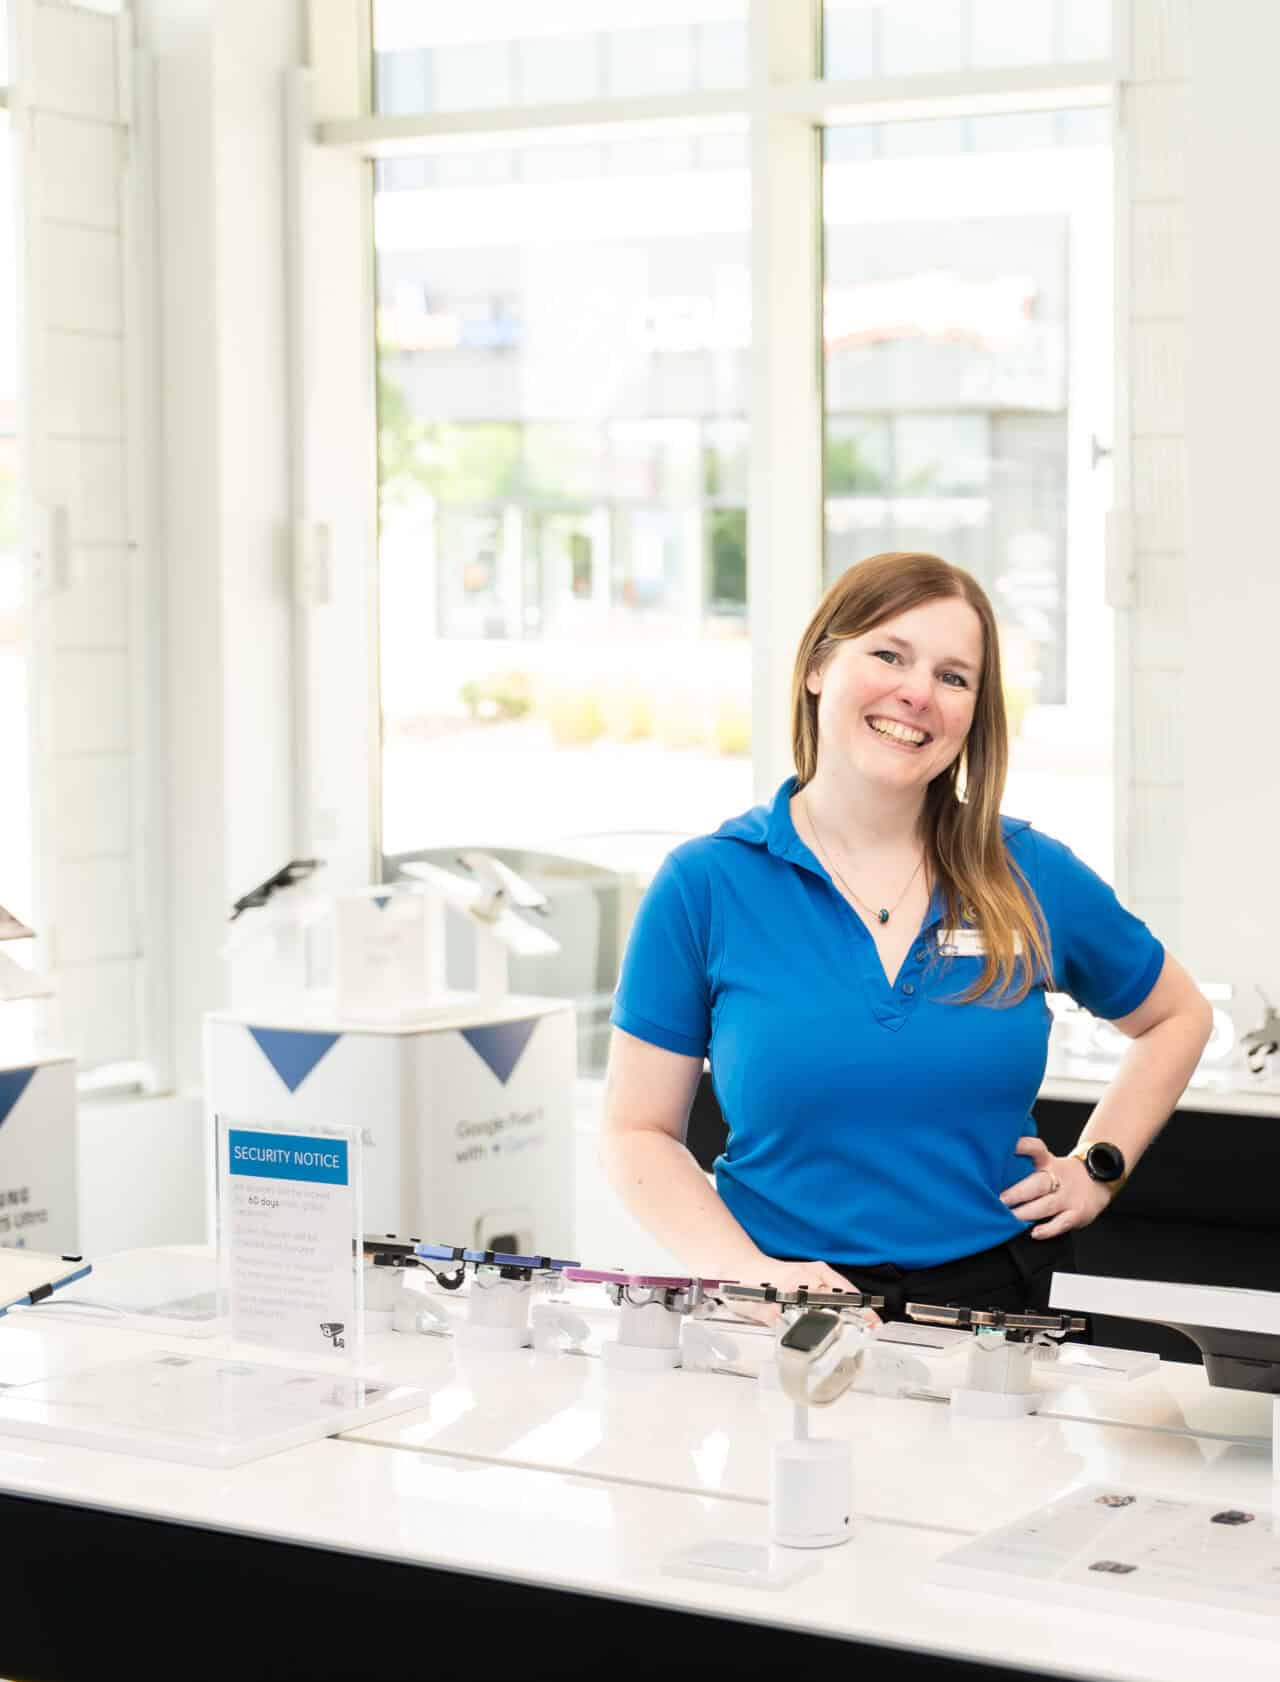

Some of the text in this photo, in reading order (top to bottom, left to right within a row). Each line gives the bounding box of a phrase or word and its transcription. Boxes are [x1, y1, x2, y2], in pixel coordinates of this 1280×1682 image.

[233, 1145, 341, 1169] SECURITY NOTICE
[261, 1197, 280, 1209] days
